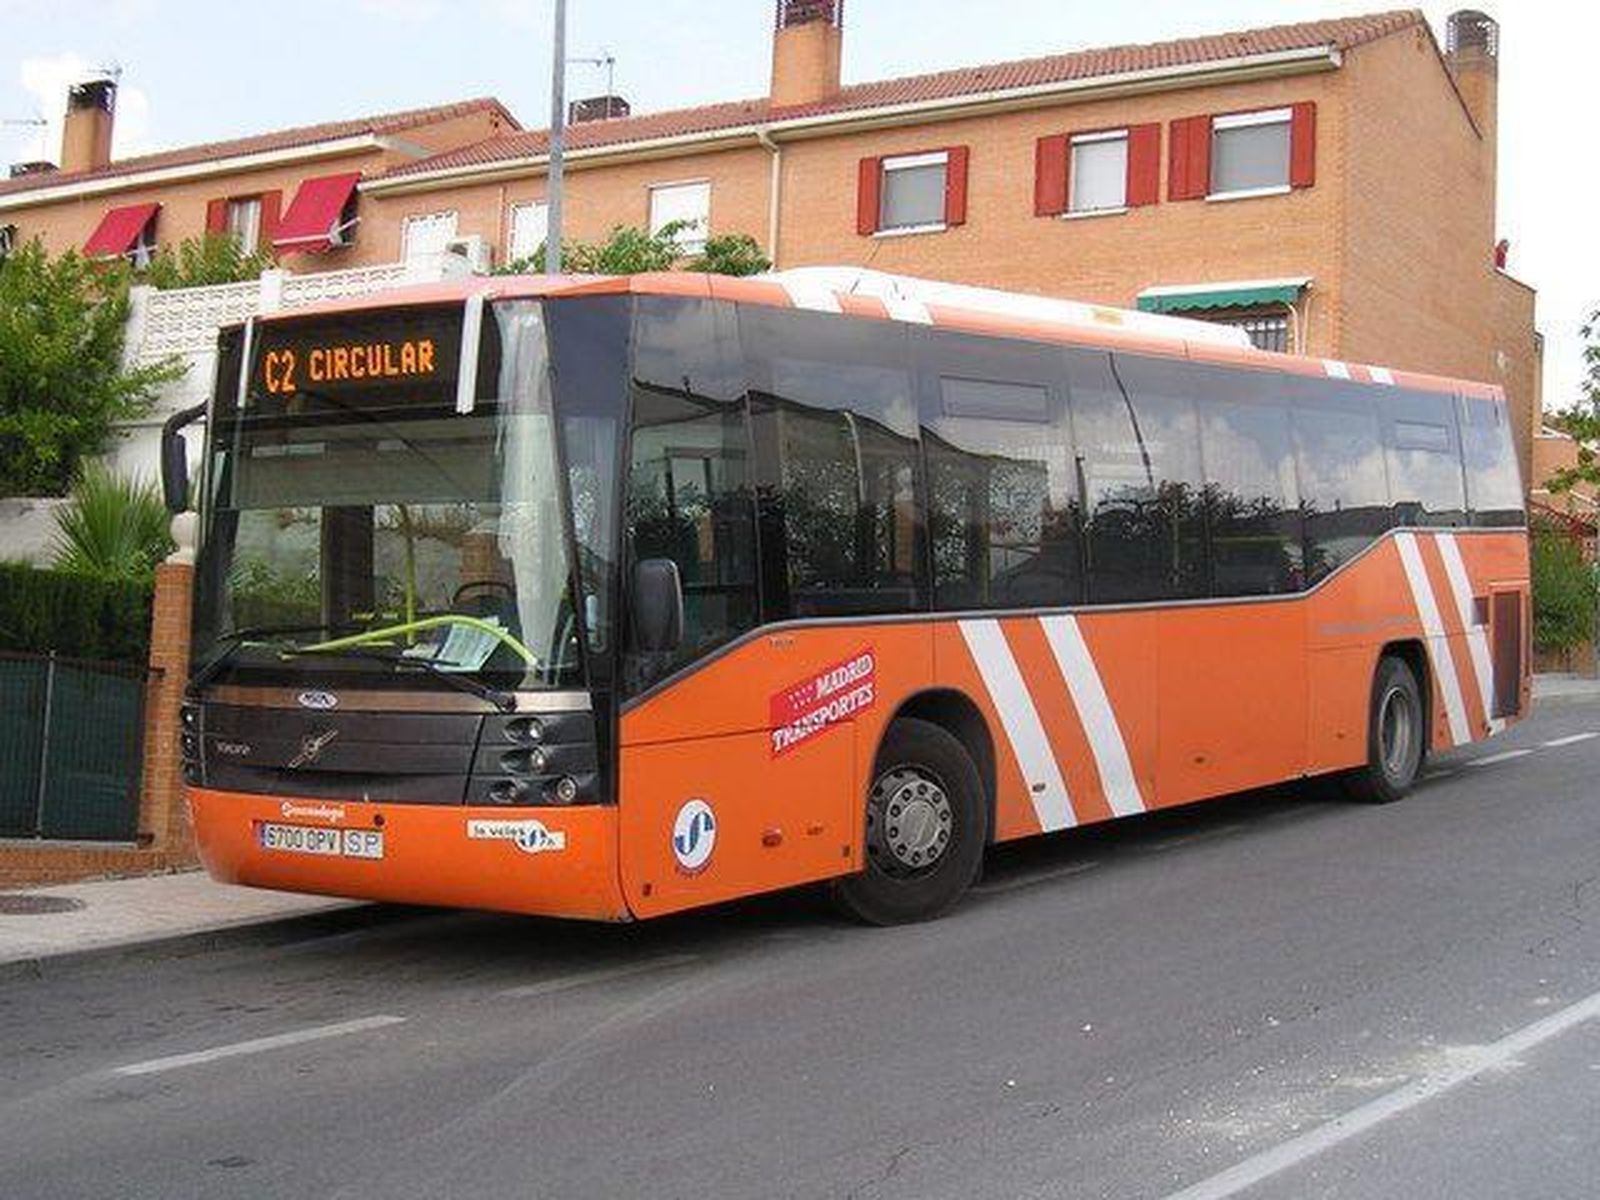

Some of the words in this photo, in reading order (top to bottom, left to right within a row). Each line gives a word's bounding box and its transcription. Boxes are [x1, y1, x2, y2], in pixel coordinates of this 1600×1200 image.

[265, 350, 296, 393] C2
[309, 339, 434, 381] CIRCULAR
[815, 654, 874, 699] MADRID
[772, 684, 874, 752] TRANSPORTES
